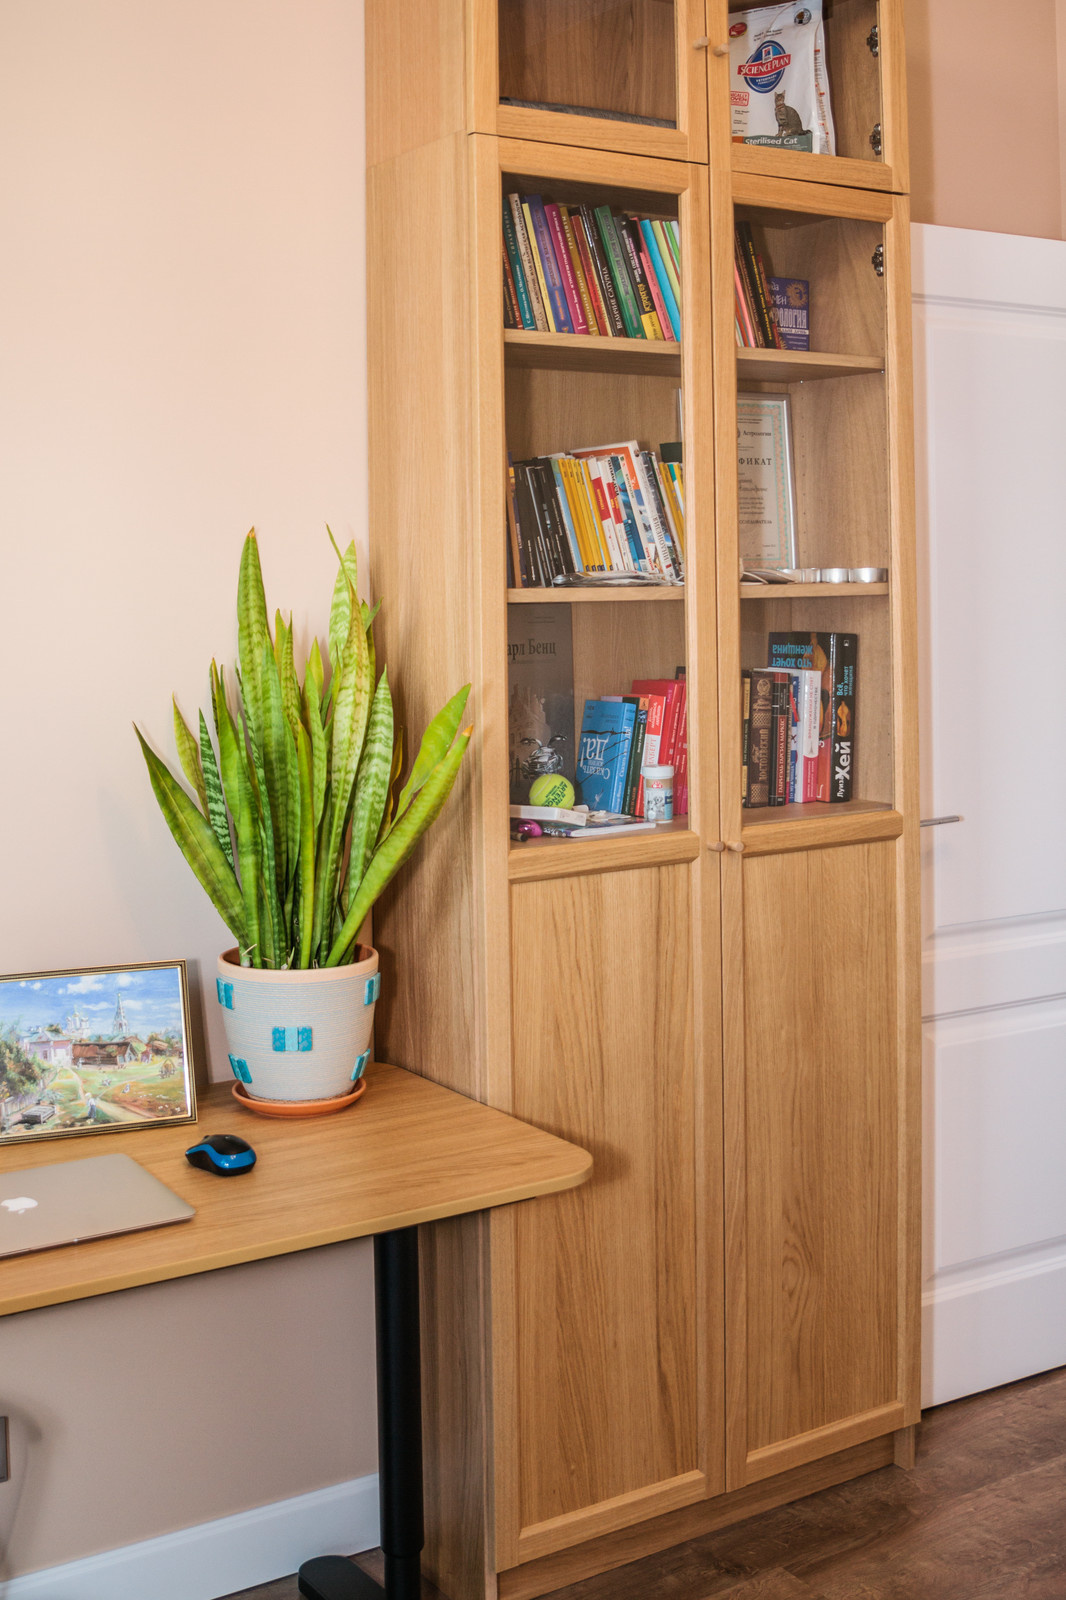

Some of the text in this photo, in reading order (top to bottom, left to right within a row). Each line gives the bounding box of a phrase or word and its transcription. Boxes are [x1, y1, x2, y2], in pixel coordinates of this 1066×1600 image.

[741, 57, 789, 75] SCIENCE PLAN
[745, 136, 798, 145] Sterilised Cat
[514, 199, 524, 231] АСТРОЛОГИЯ
[561, 215, 573, 249] ТРАНЗИТЫ
[601, 266, 622, 329] ВЕЛИЧИЕ САТУРНА
[624, 473, 634, 498] ИСПАНИЯ
[651, 516, 669, 560] ИНДОНЕЗИЯ
[507, 638, 557, 660] арл Бенц
[772, 643, 813, 654] женщина
[772, 657, 812, 668] что хочет
[836, 681, 844, 696] Всё,
[580, 735, 610, 767] Да!
[835, 741, 851, 780] Хей
[583, 765, 610, 780] Сказать
[837, 776, 845, 798] Луиза
